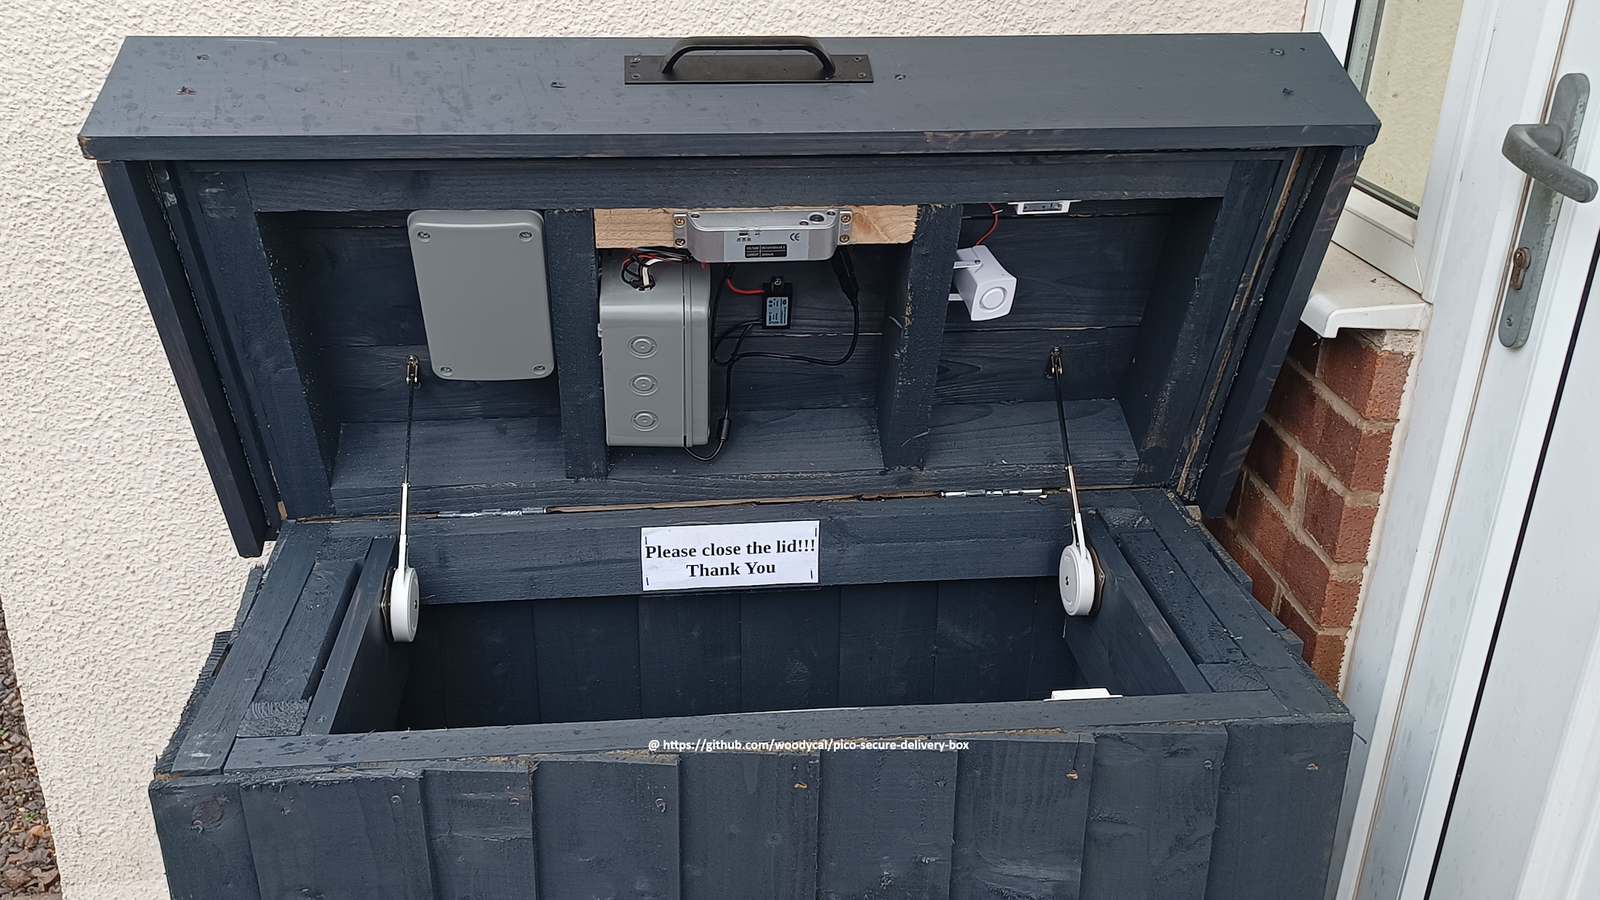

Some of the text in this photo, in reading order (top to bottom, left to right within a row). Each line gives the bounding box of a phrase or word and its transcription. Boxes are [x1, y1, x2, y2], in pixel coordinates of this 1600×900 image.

[790, 233, 800, 241] CE
[645, 539, 815, 558] Please close the lid!!!
[686, 561, 776, 577] Thank You
